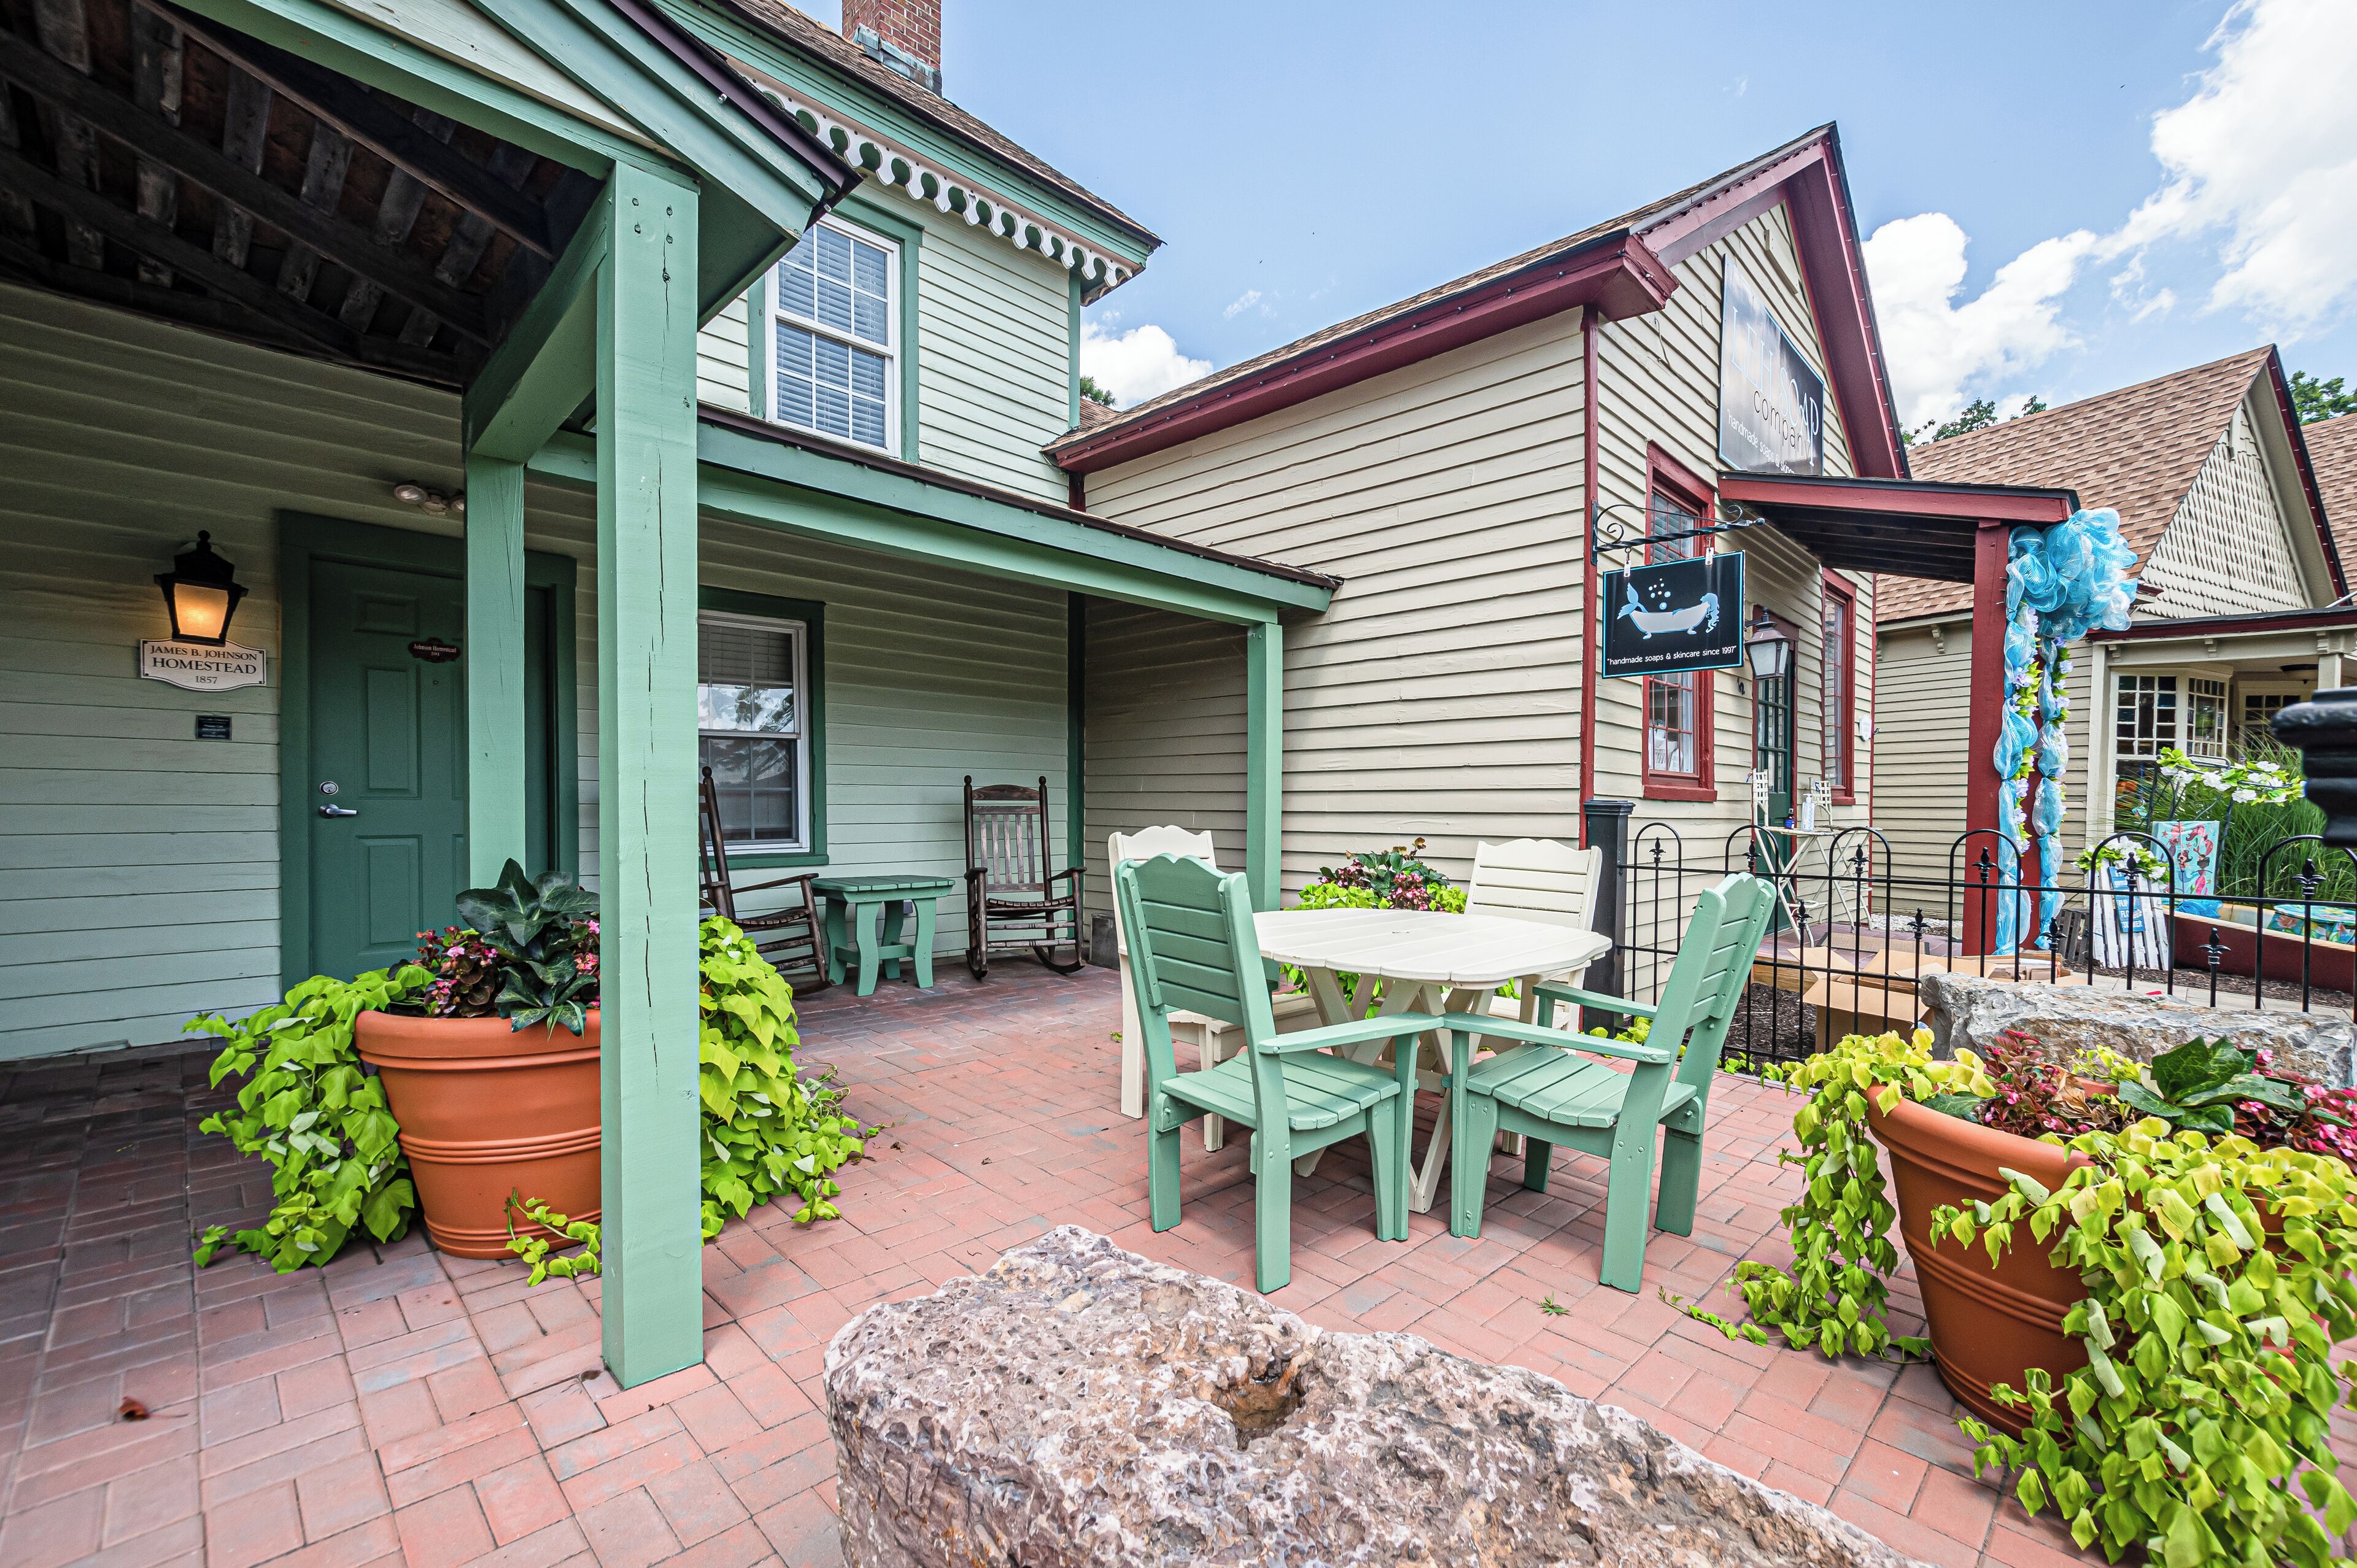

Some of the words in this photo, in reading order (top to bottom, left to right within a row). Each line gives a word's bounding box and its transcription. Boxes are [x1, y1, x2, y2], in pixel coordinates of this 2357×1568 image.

[1731, 306, 1773, 404] LEH
[1779, 367, 1819, 467] SOAP
[1754, 390, 1810, 461] company
[1759, 442, 1775, 463] soaps
[1775, 454, 1780, 468] &
[150, 645, 188, 655] JAMES
[204, 649, 257, 661] JOHNSON
[153, 657, 257, 674] HOMESTEAD
[196, 676, 217, 684] 1857
